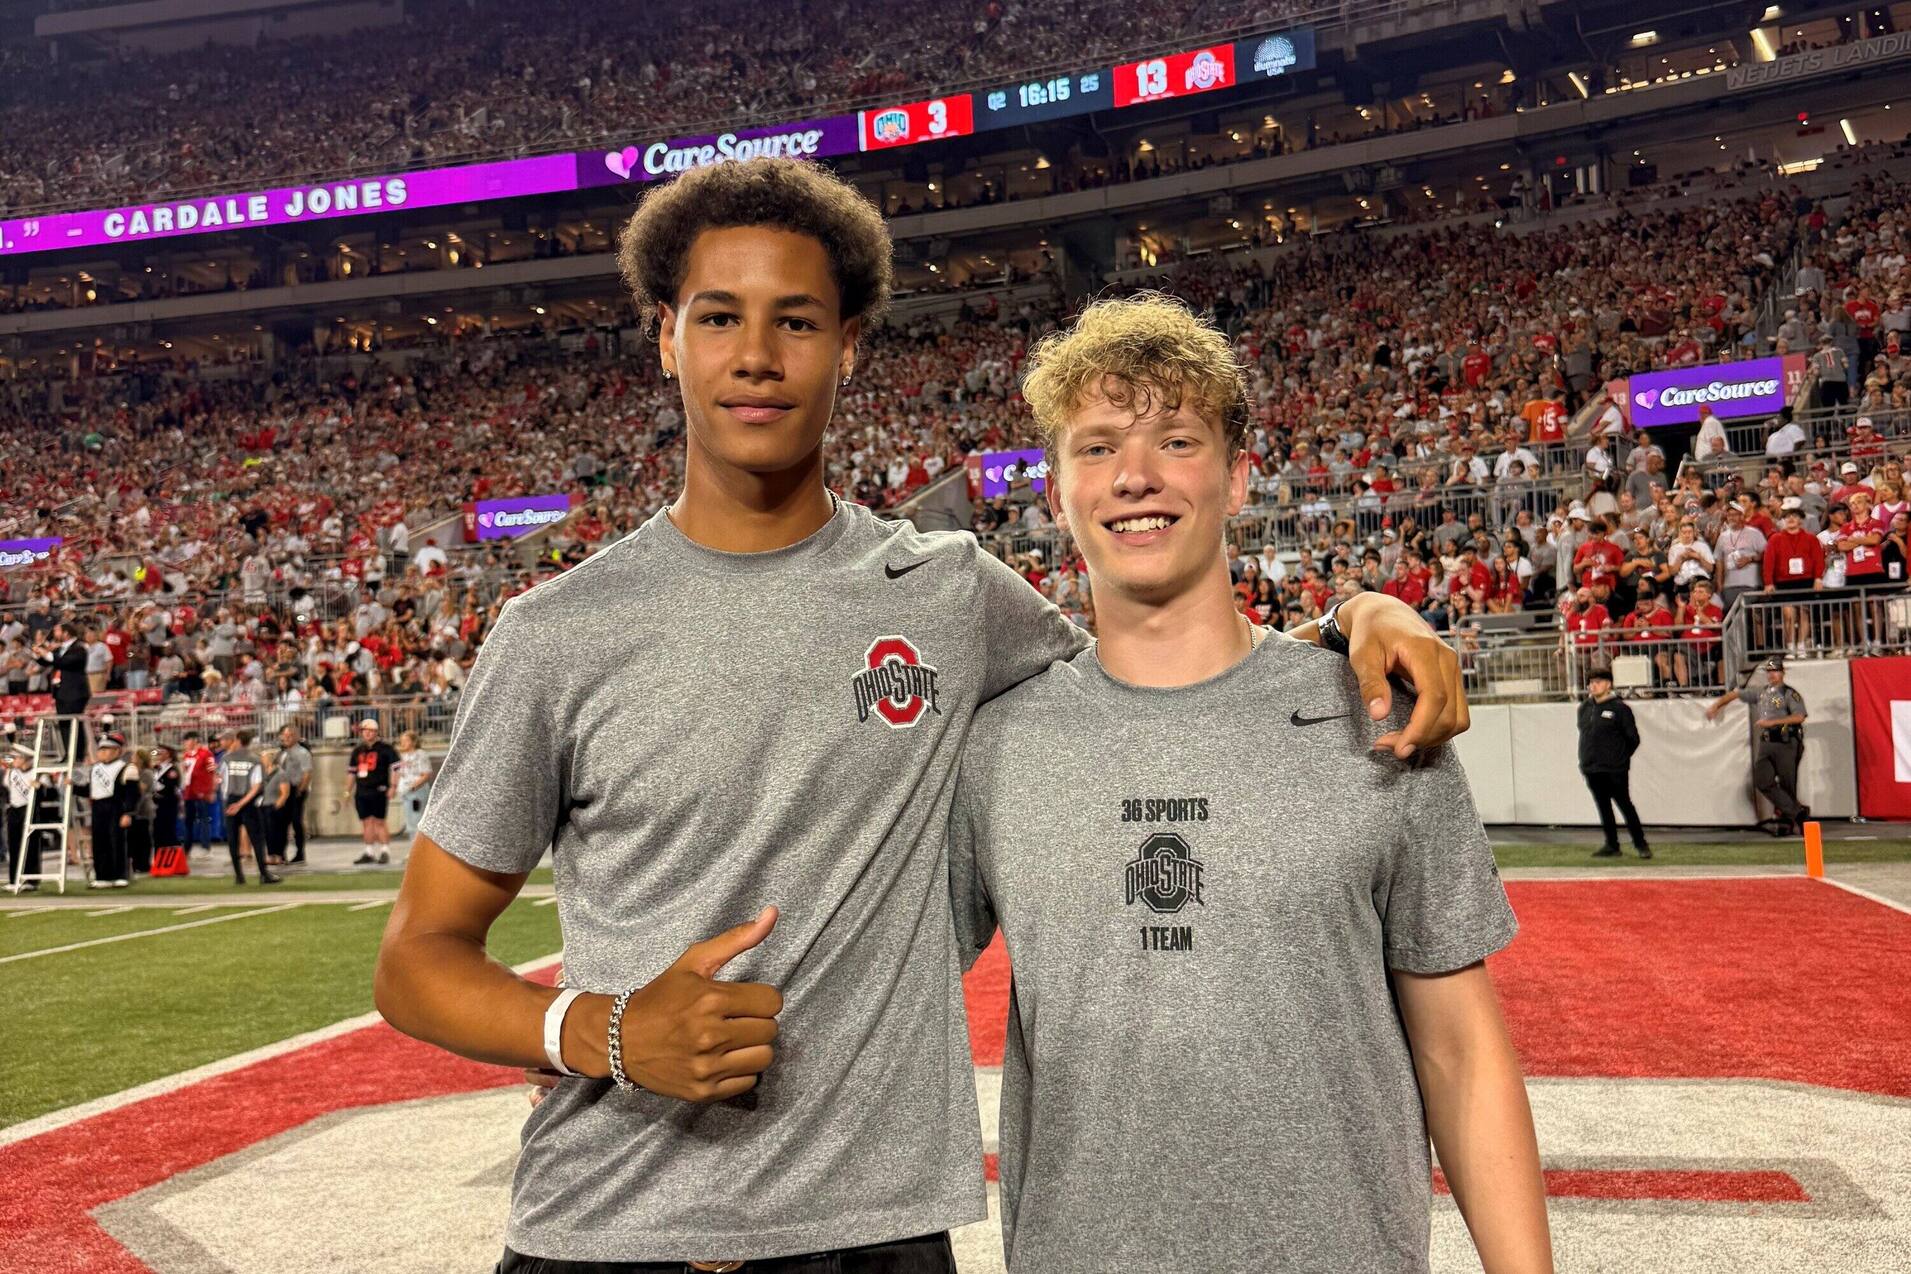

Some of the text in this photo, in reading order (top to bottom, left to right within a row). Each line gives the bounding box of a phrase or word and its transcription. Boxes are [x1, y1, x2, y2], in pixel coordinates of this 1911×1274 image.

[1136, 61, 1167, 96] 13
[1730, 54, 1823, 88] NETJETS
[1019, 78, 1070, 107] 16:15
[928, 101, 947, 133] 3
[644, 130, 821, 175] CareSource
[104, 196, 269, 237] CARDALE
[284, 179, 407, 216] JONES
[1660, 380, 1780, 407] CareSource
[1121, 798, 1209, 822] 36 SPORTS
[1140, 926, 1193, 951] 1 TEAM
